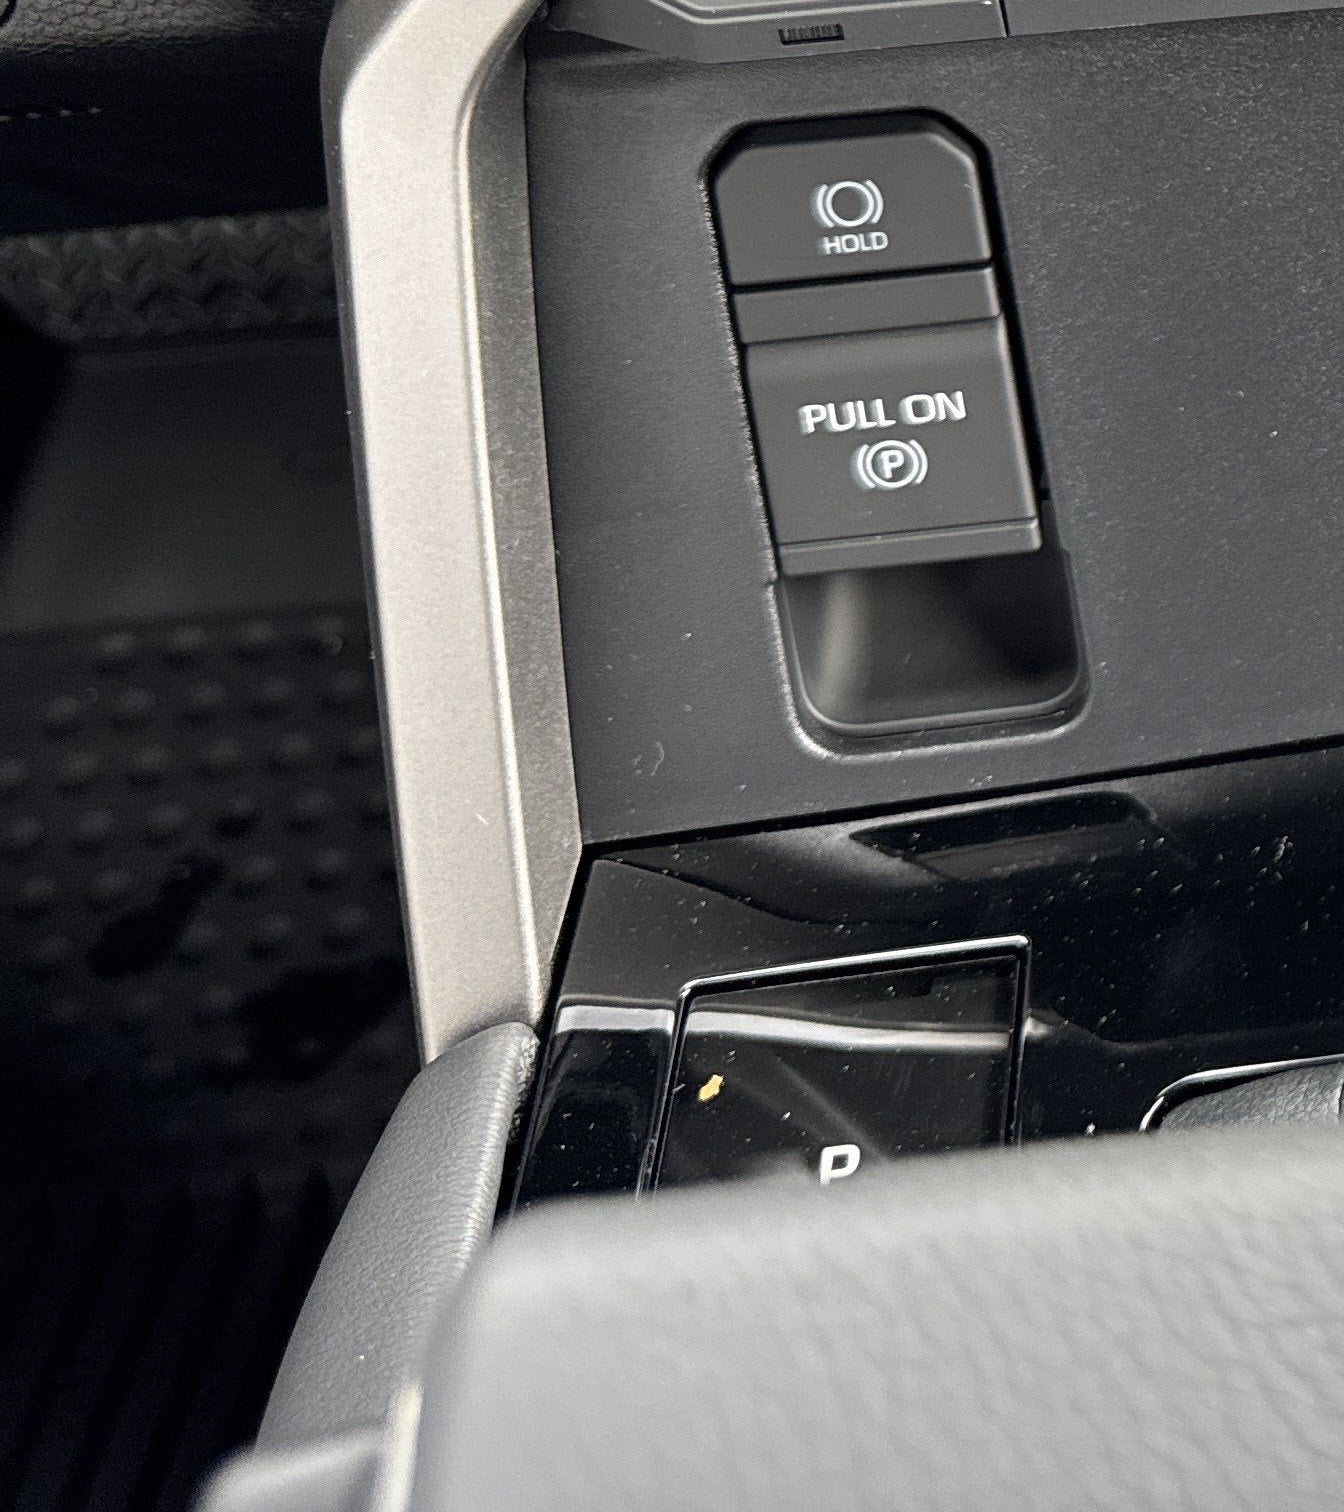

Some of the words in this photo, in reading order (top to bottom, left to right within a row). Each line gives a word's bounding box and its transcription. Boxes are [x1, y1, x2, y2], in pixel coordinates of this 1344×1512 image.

[822, 231, 889, 255] HOLD
[799, 397, 897, 434] PULL
[899, 390, 967, 426] ON
[880, 449, 905, 479] P
[819, 1143, 861, 1186] P
